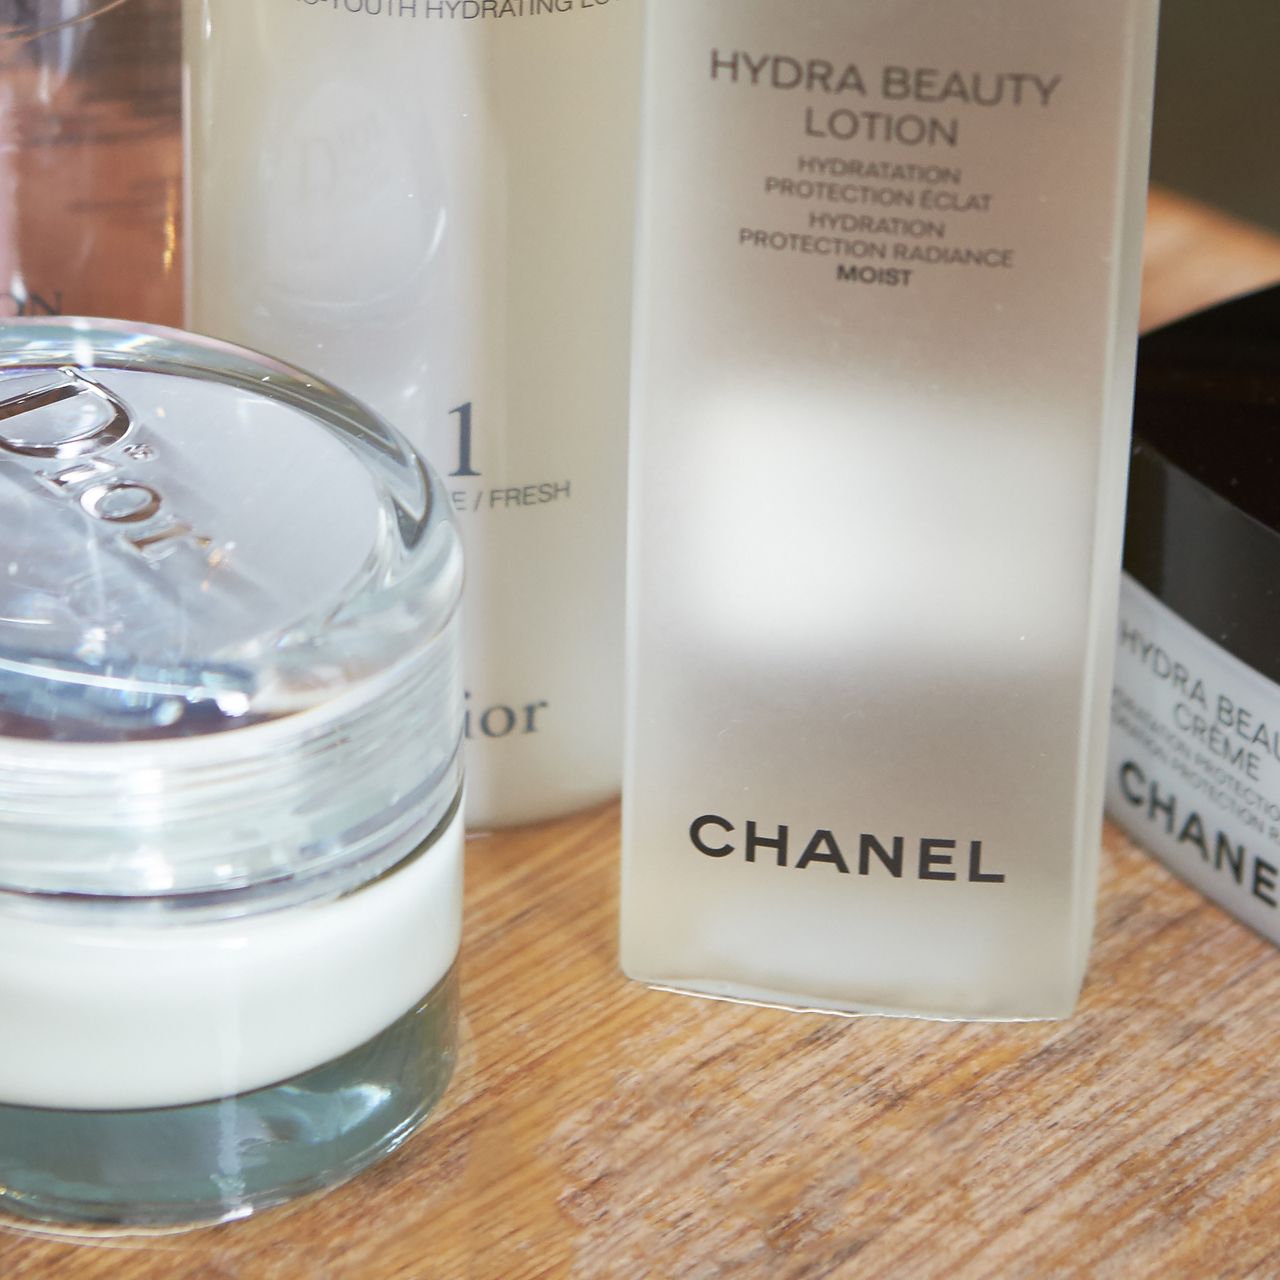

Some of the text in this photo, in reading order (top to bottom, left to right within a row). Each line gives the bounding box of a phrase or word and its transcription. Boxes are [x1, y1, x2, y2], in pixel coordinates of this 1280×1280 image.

[710, 47, 1063, 108] HYDRA BEAUTY
[803, 106, 960, 148] LOTION
[797, 155, 962, 185] HYDRATATION
[764, 176, 915, 207] PROTECTION
[808, 211, 946, 239] HYDRATION
[739, 227, 1015, 269] PROTECTION RADIANCE
[836, 264, 914, 288] MOIST
[447, 401, 483, 477] 1
[489, 479, 572, 510] FRESH
[1120, 621, 1208, 711] HYDRA
[464, 690, 549, 740] ior
[688, 814, 1006, 884] CHANEL
